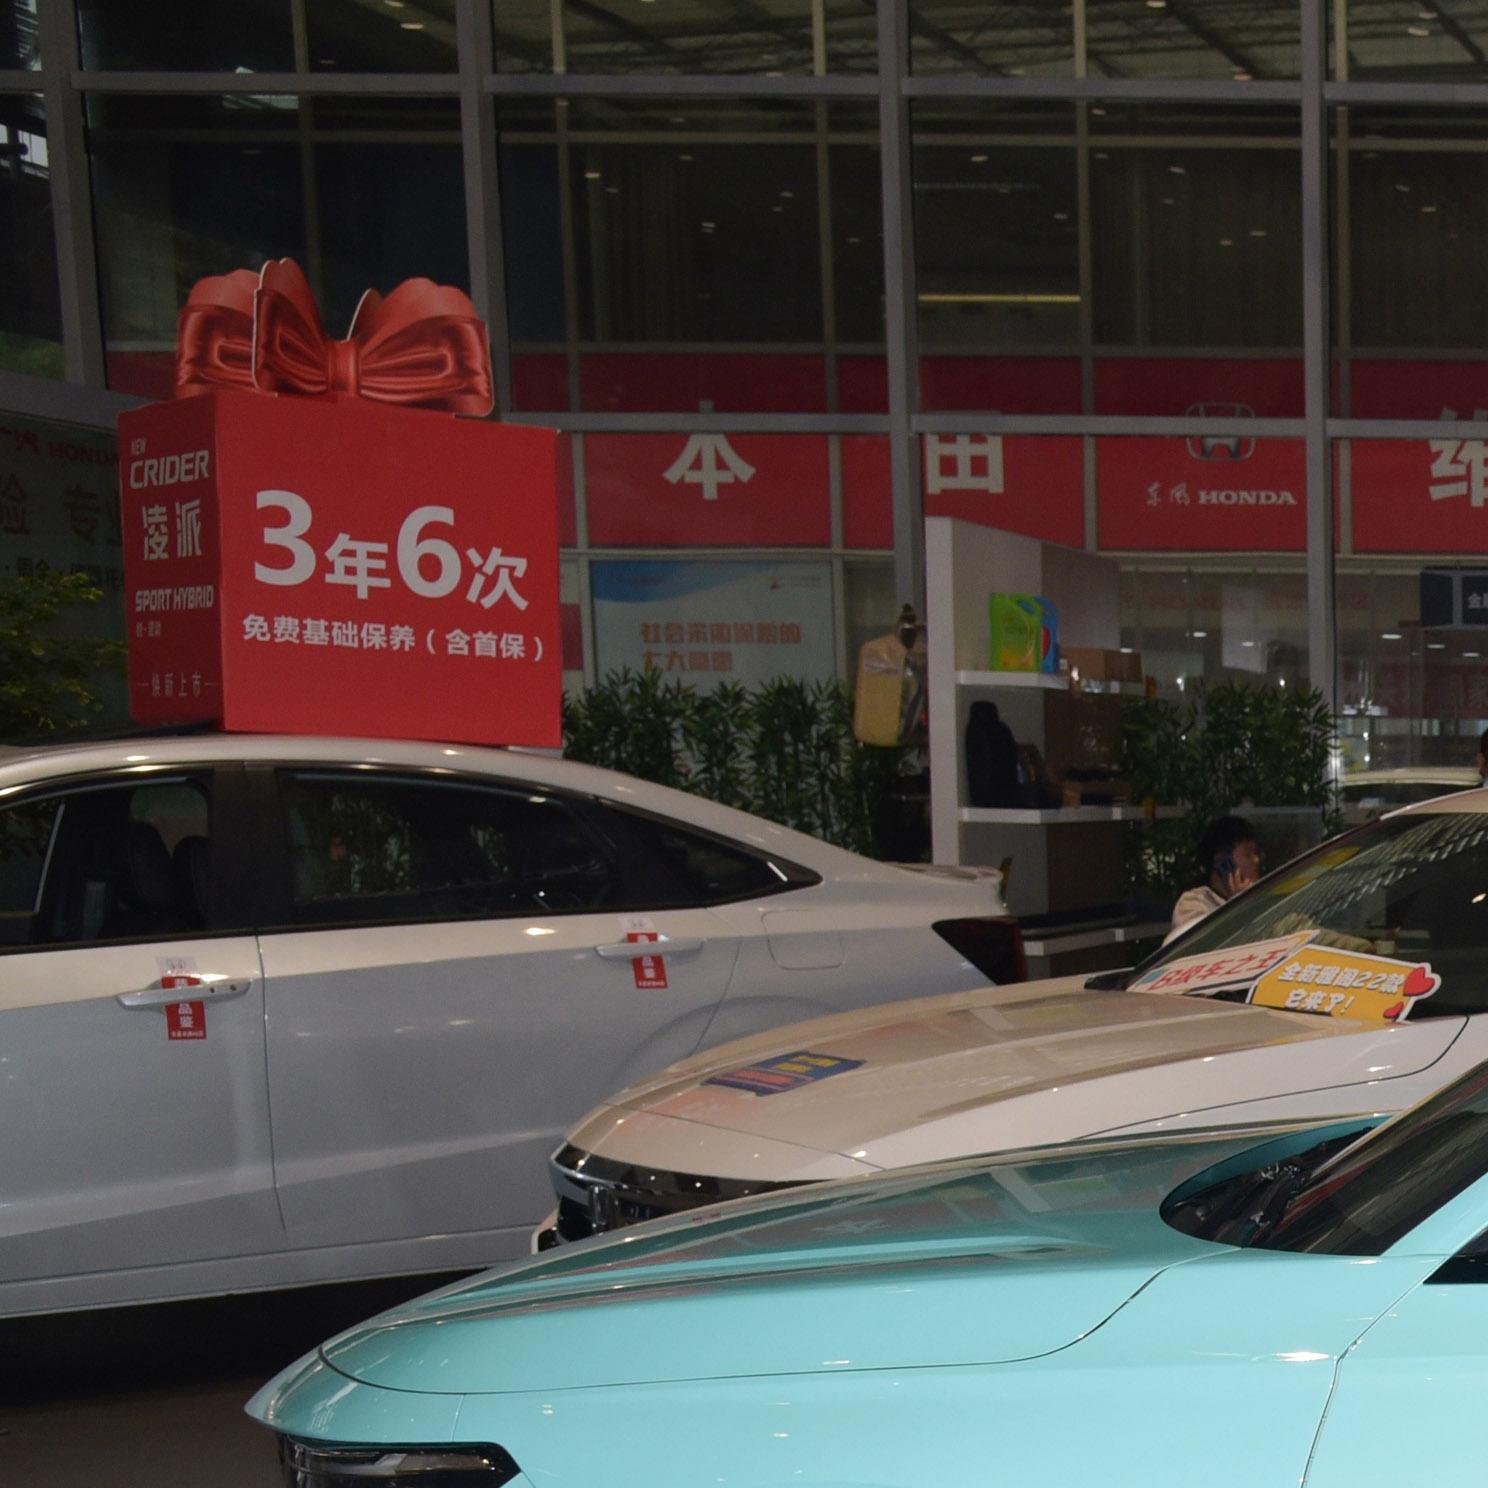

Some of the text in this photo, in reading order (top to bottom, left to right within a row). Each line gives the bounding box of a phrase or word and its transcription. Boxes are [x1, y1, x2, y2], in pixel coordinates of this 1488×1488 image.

[129, 449, 210, 490] CRIDER
[1198, 490, 1298, 506] HONDA
[142, 499, 202, 561] 凌派
[254, 489, 530, 612] 3年6次
[135, 585, 214, 612] SPORT HYBRID
[1277, 962, 1406, 997] 全新雅阁22款
